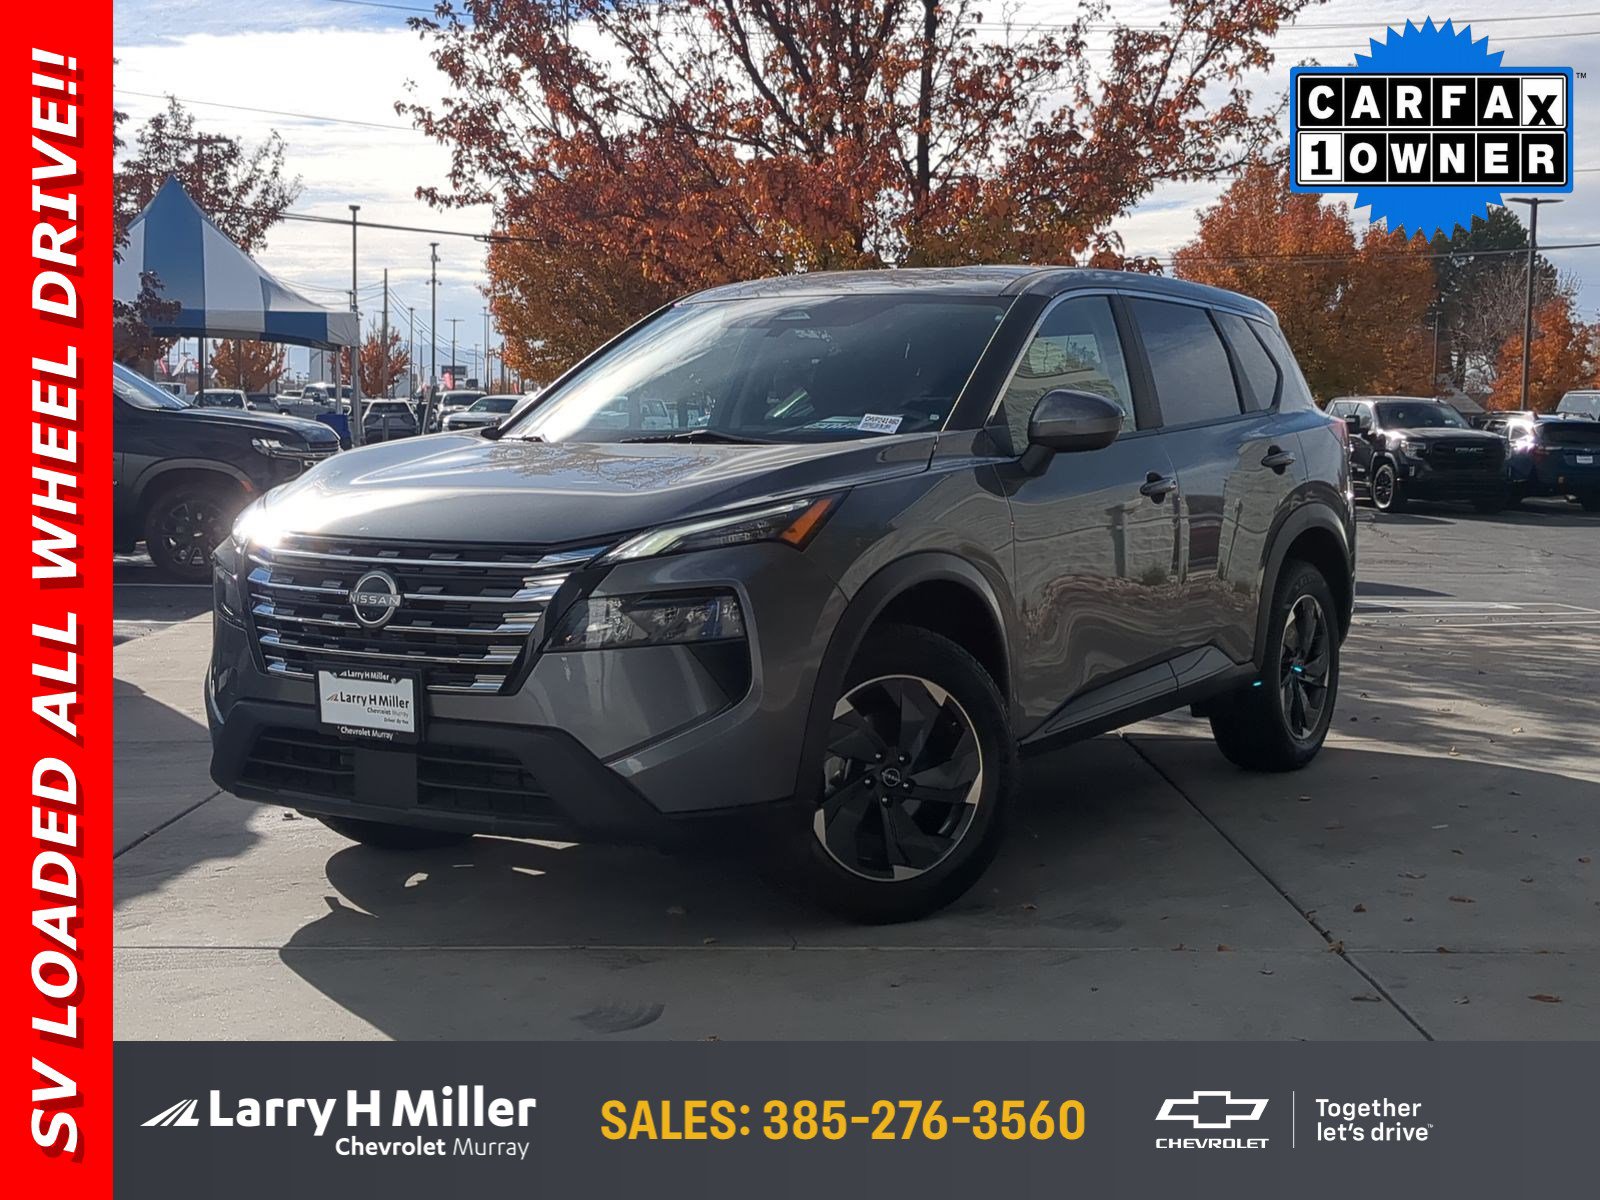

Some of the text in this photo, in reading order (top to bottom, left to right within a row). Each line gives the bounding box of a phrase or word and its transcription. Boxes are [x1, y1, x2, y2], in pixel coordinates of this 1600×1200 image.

[349, 592, 400, 607] NISSAN
[347, 669, 365, 680] Larry
[370, 672, 390, 681] Miller
[340, 691, 409, 709] Larry H Miller
[340, 725, 394, 741] Chevrolet Murray
